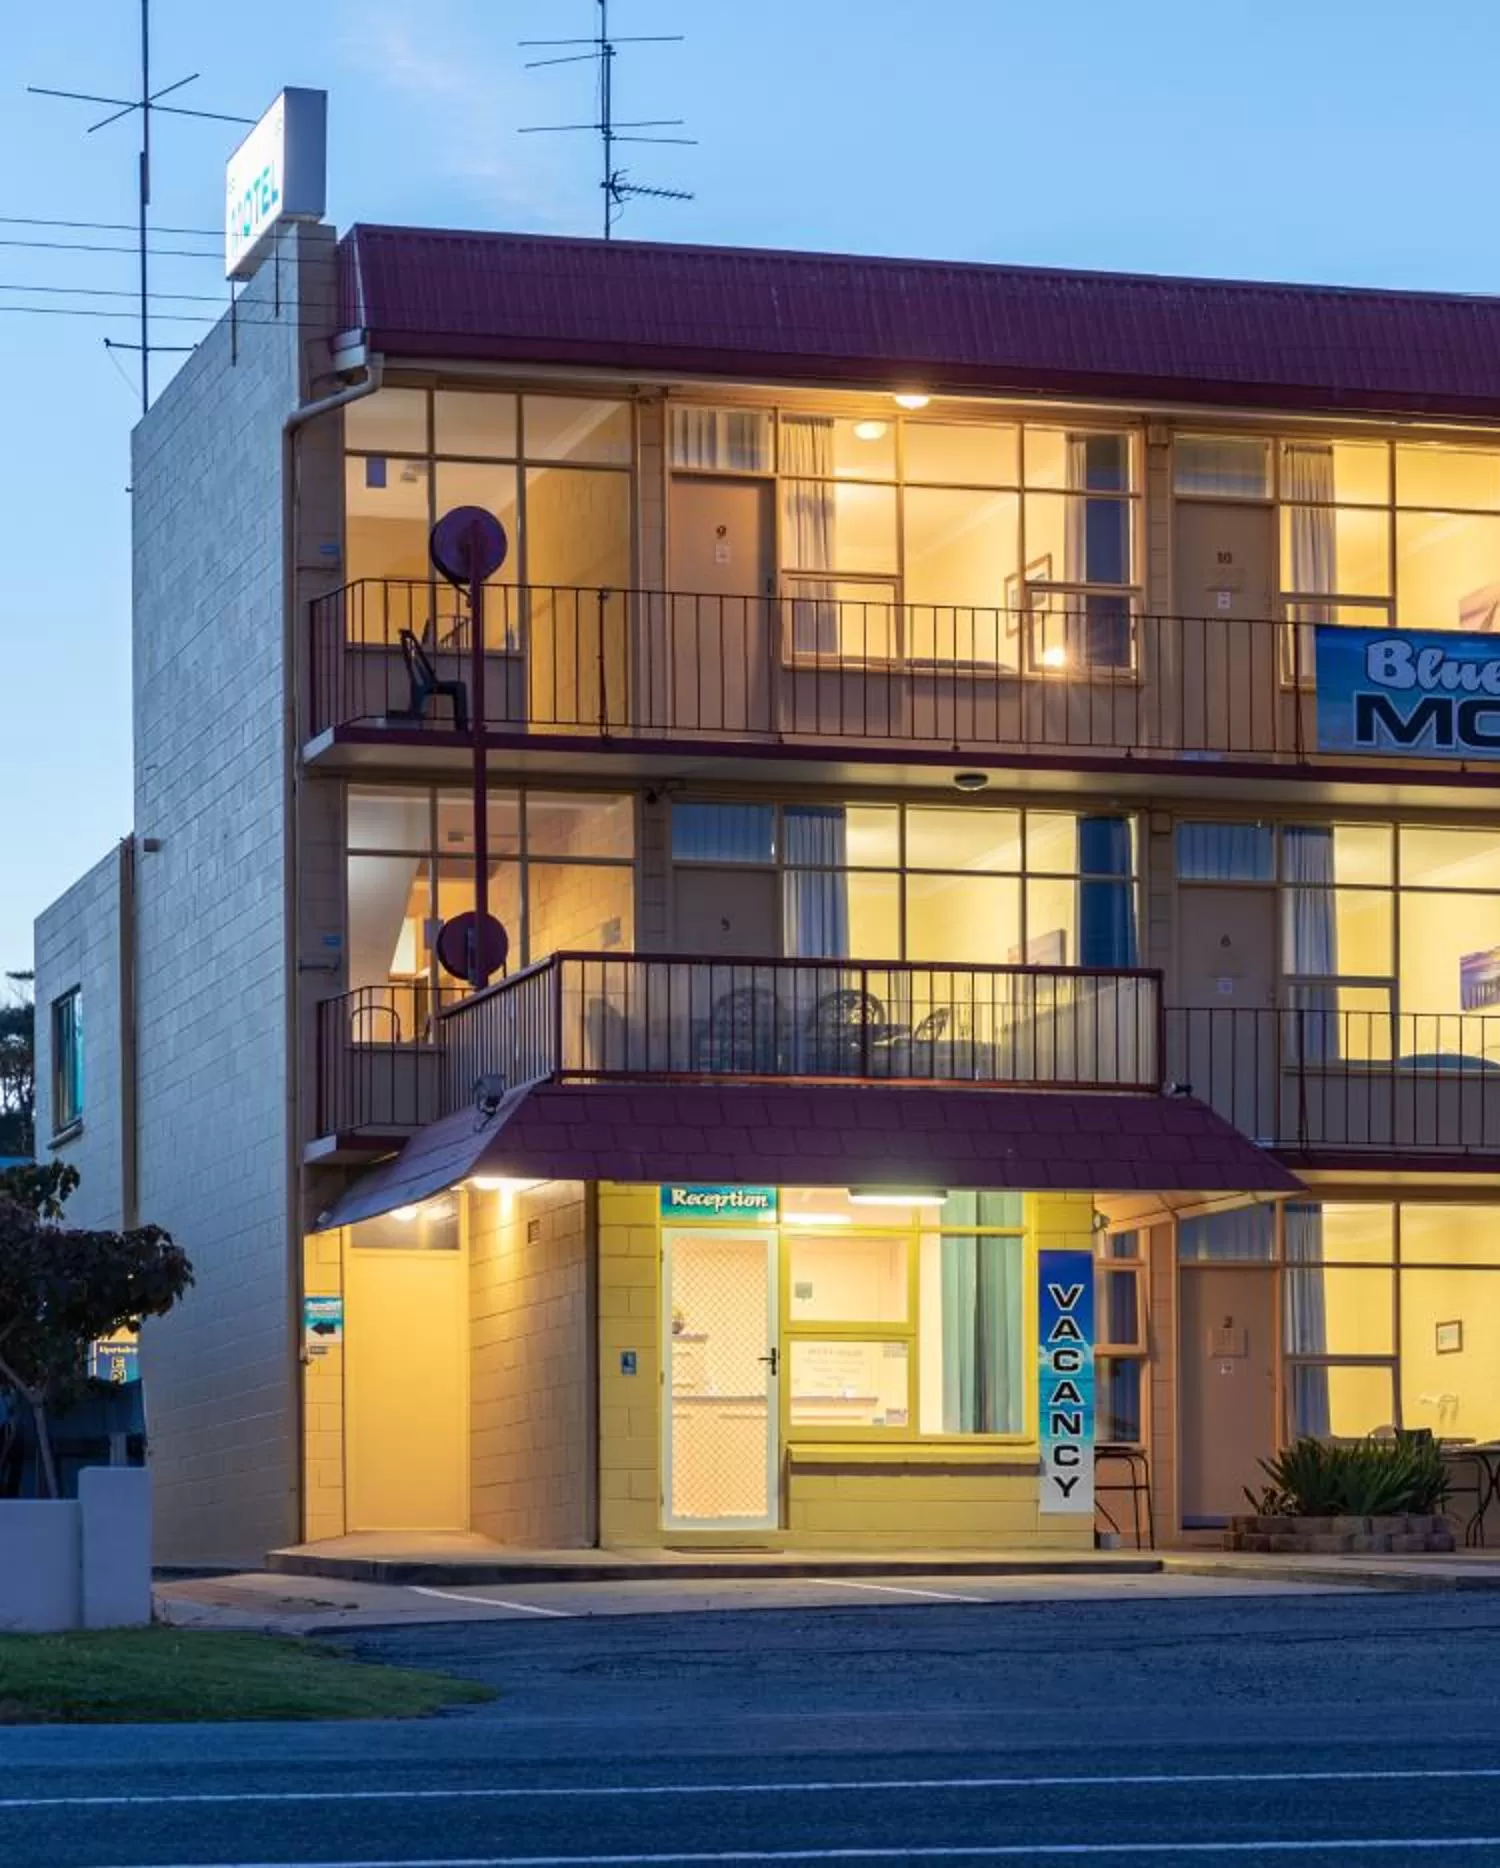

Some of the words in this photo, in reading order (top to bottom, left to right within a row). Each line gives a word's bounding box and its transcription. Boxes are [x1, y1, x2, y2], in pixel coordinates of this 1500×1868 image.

[716, 525, 727, 539] 9
[1216, 551, 1232, 564] 10
[1220, 935, 1231, 947] 6
[670, 1187, 769, 1214] Reception
[1047, 1283, 1085, 1499] VACANCY
